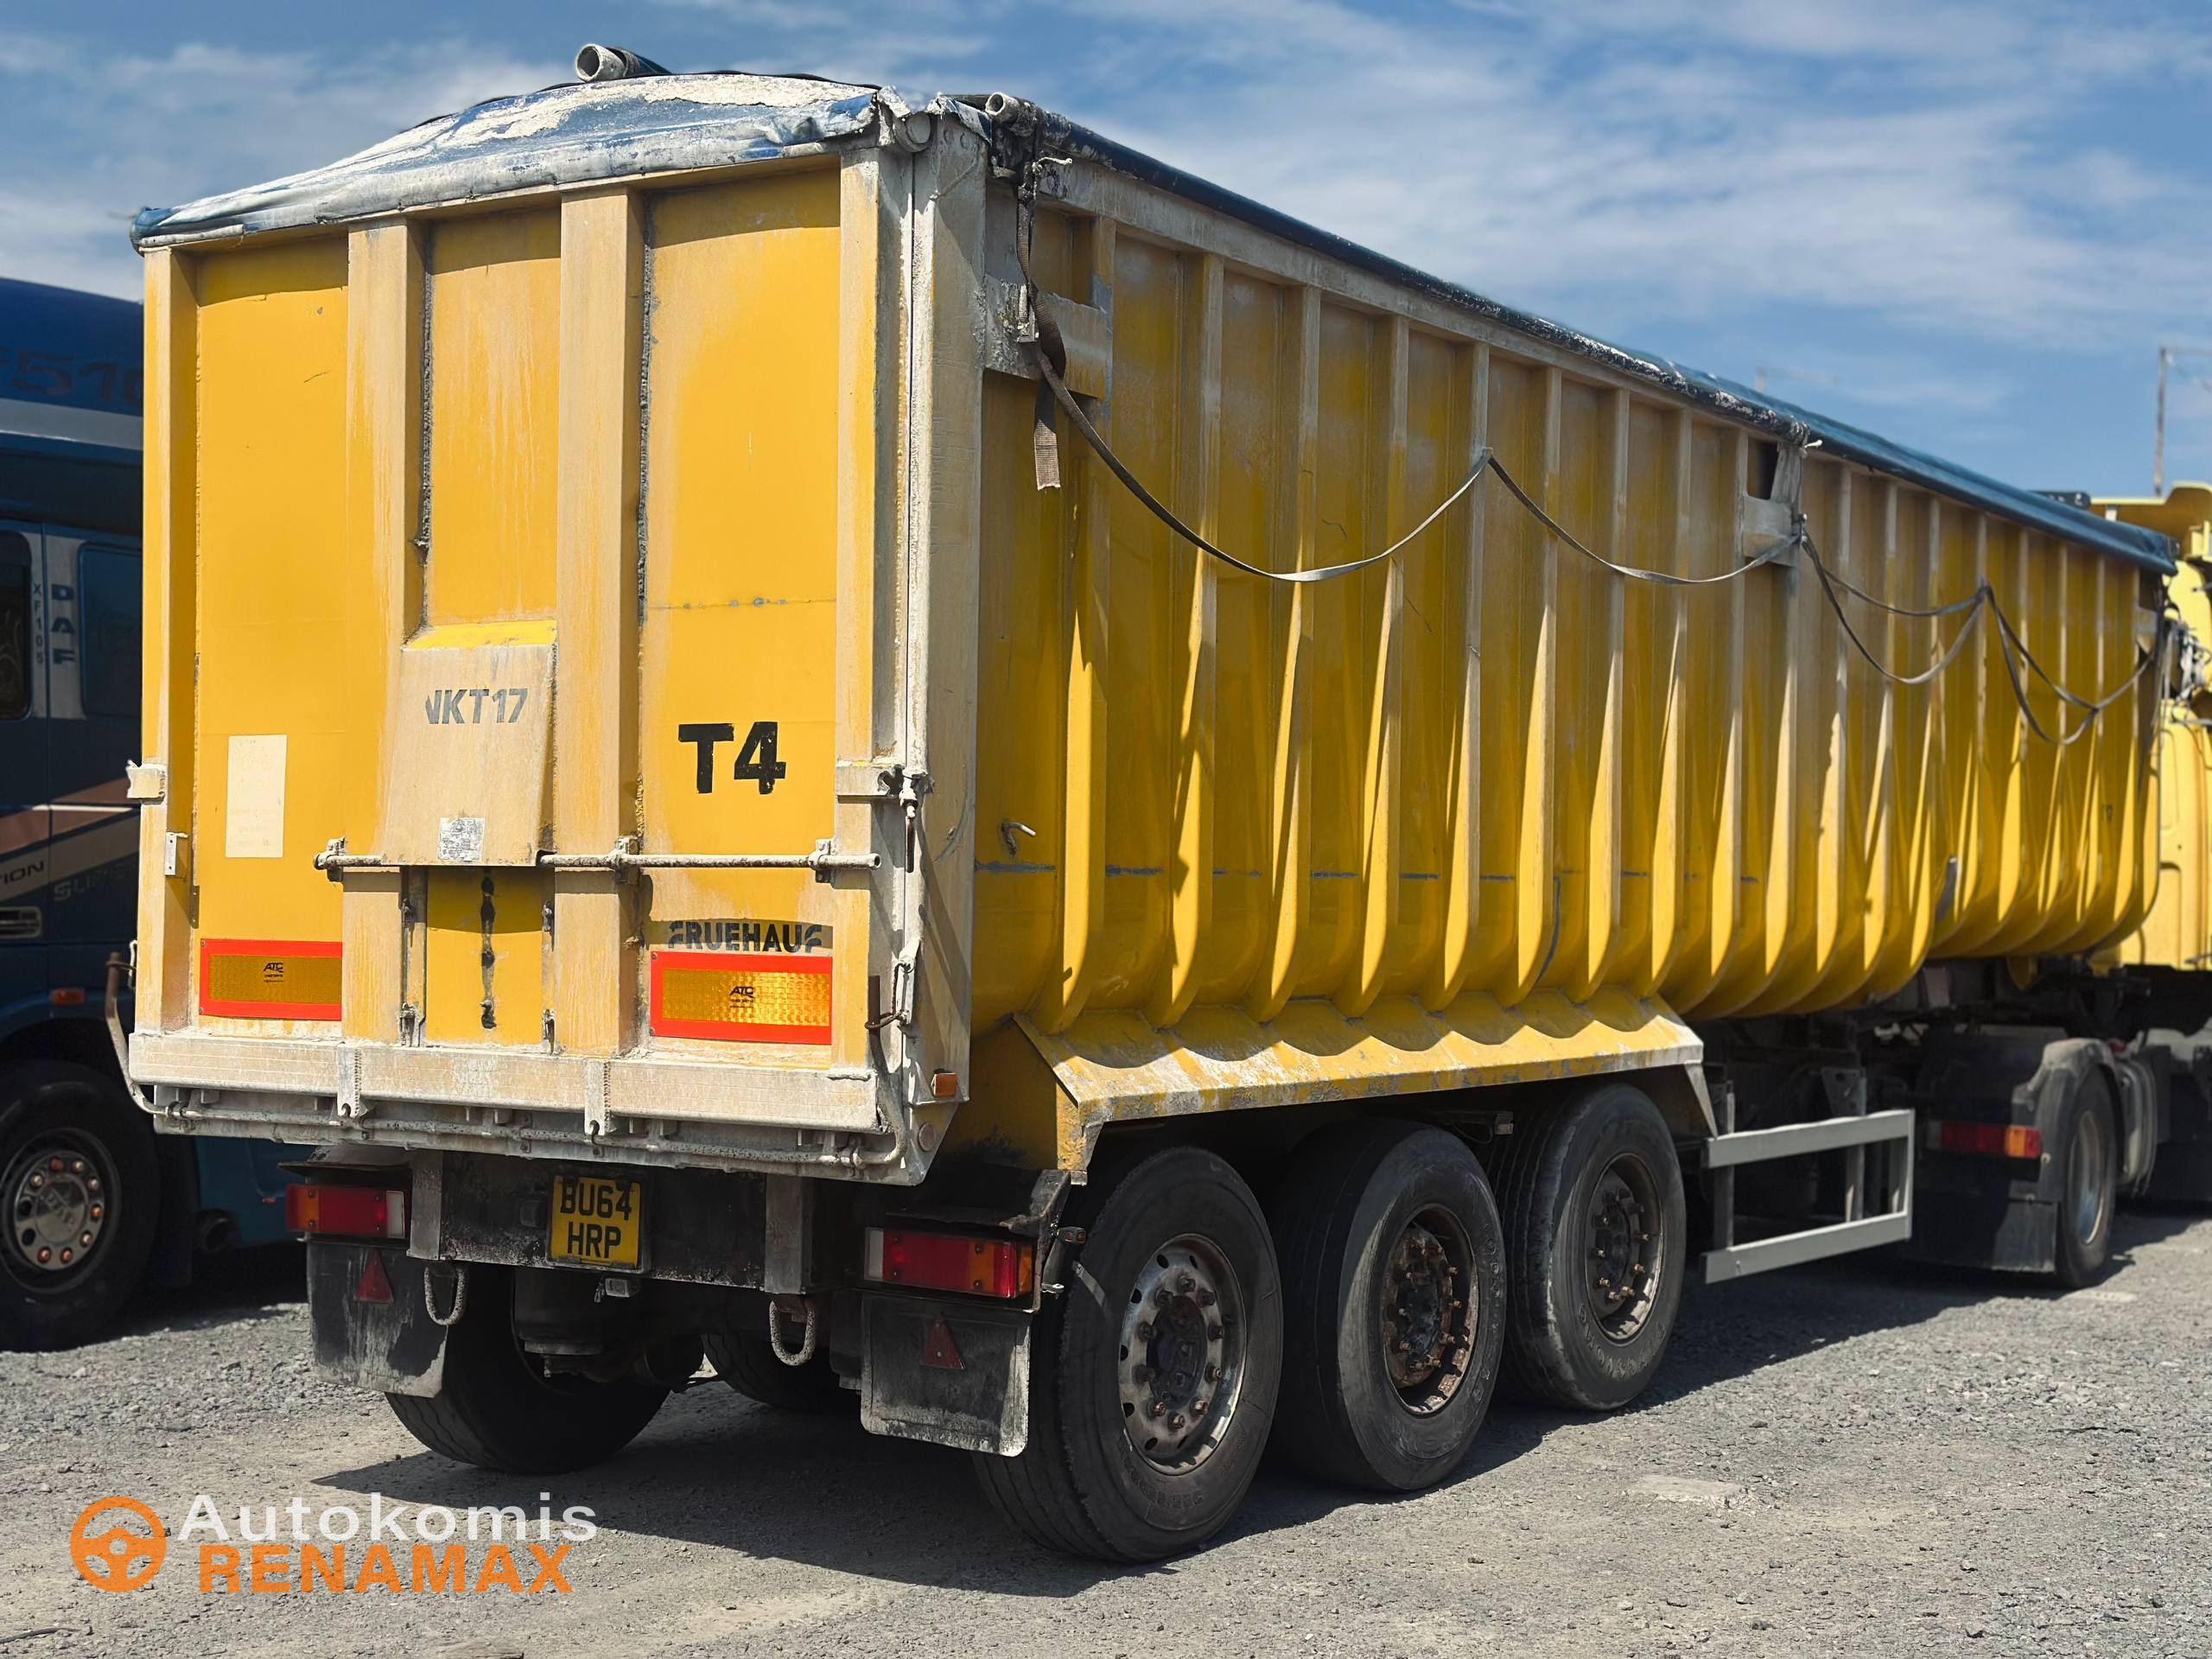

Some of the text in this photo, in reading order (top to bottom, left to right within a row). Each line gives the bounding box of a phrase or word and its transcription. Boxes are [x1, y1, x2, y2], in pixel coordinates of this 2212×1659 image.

[52, 583, 76, 665] DAF
[678, 721, 786, 794] T4
[0, 861, 44, 886] ION
[263, 963, 284, 974] ATC
[729, 986, 755, 999] ATC
[560, 1180, 632, 1221] BU64
[567, 1221, 622, 1259] HRP
